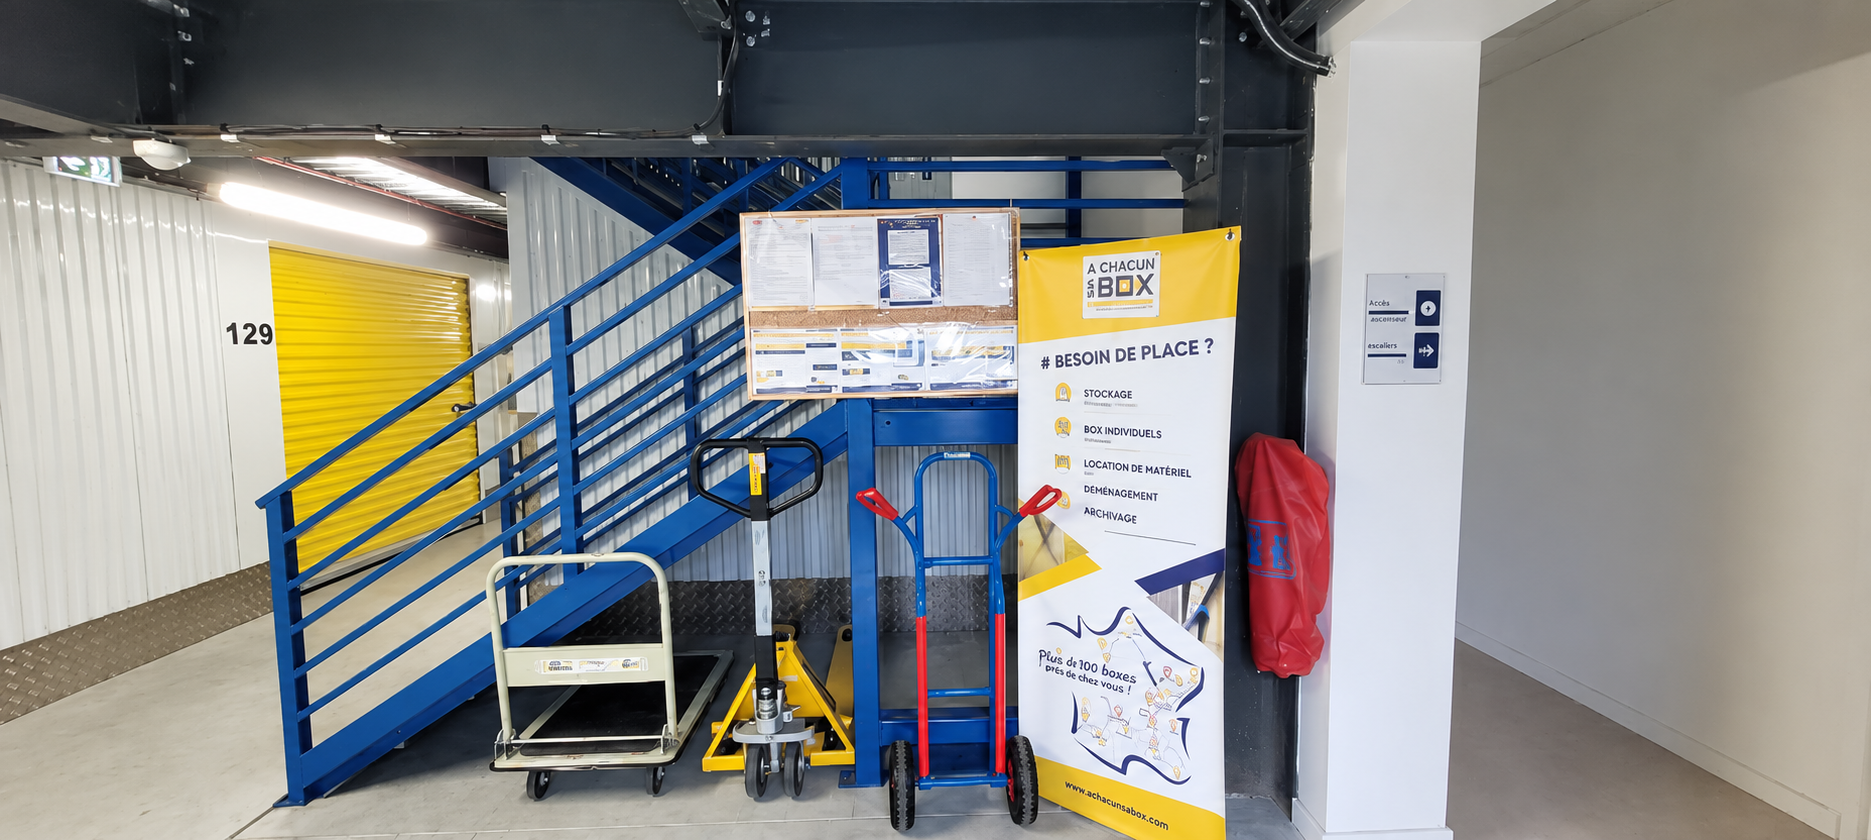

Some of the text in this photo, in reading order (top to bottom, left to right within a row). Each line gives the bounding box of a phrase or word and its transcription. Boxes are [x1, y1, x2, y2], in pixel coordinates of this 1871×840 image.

[1087, 257, 1155, 274] A CHACUN
[1098, 273, 1155, 298] BOX
[226, 322, 273, 345] 129
[1055, 349, 1111, 369] BESOIN
[1115, 346, 1136, 364] DE
[1141, 339, 1199, 360] PLACE
[1084, 389, 1133, 400] STOCKAGE
[1084, 425, 1162, 439] BOX INDIVIDUELS
[1084, 459, 1192, 479] LOCATION DE MATÉRIEL
[1084, 506, 1137, 524] ARCHIVAGE
[1039, 649, 1063, 667] Plus
[1079, 659, 1098, 673] 100
[1101, 663, 1137, 684] boxes
[1066, 670, 1076, 680] de
[1078, 674, 1099, 686] chez
[1100, 680, 1124, 693] vous
[1065, 781, 1169, 830] www.achacunsabox.com
